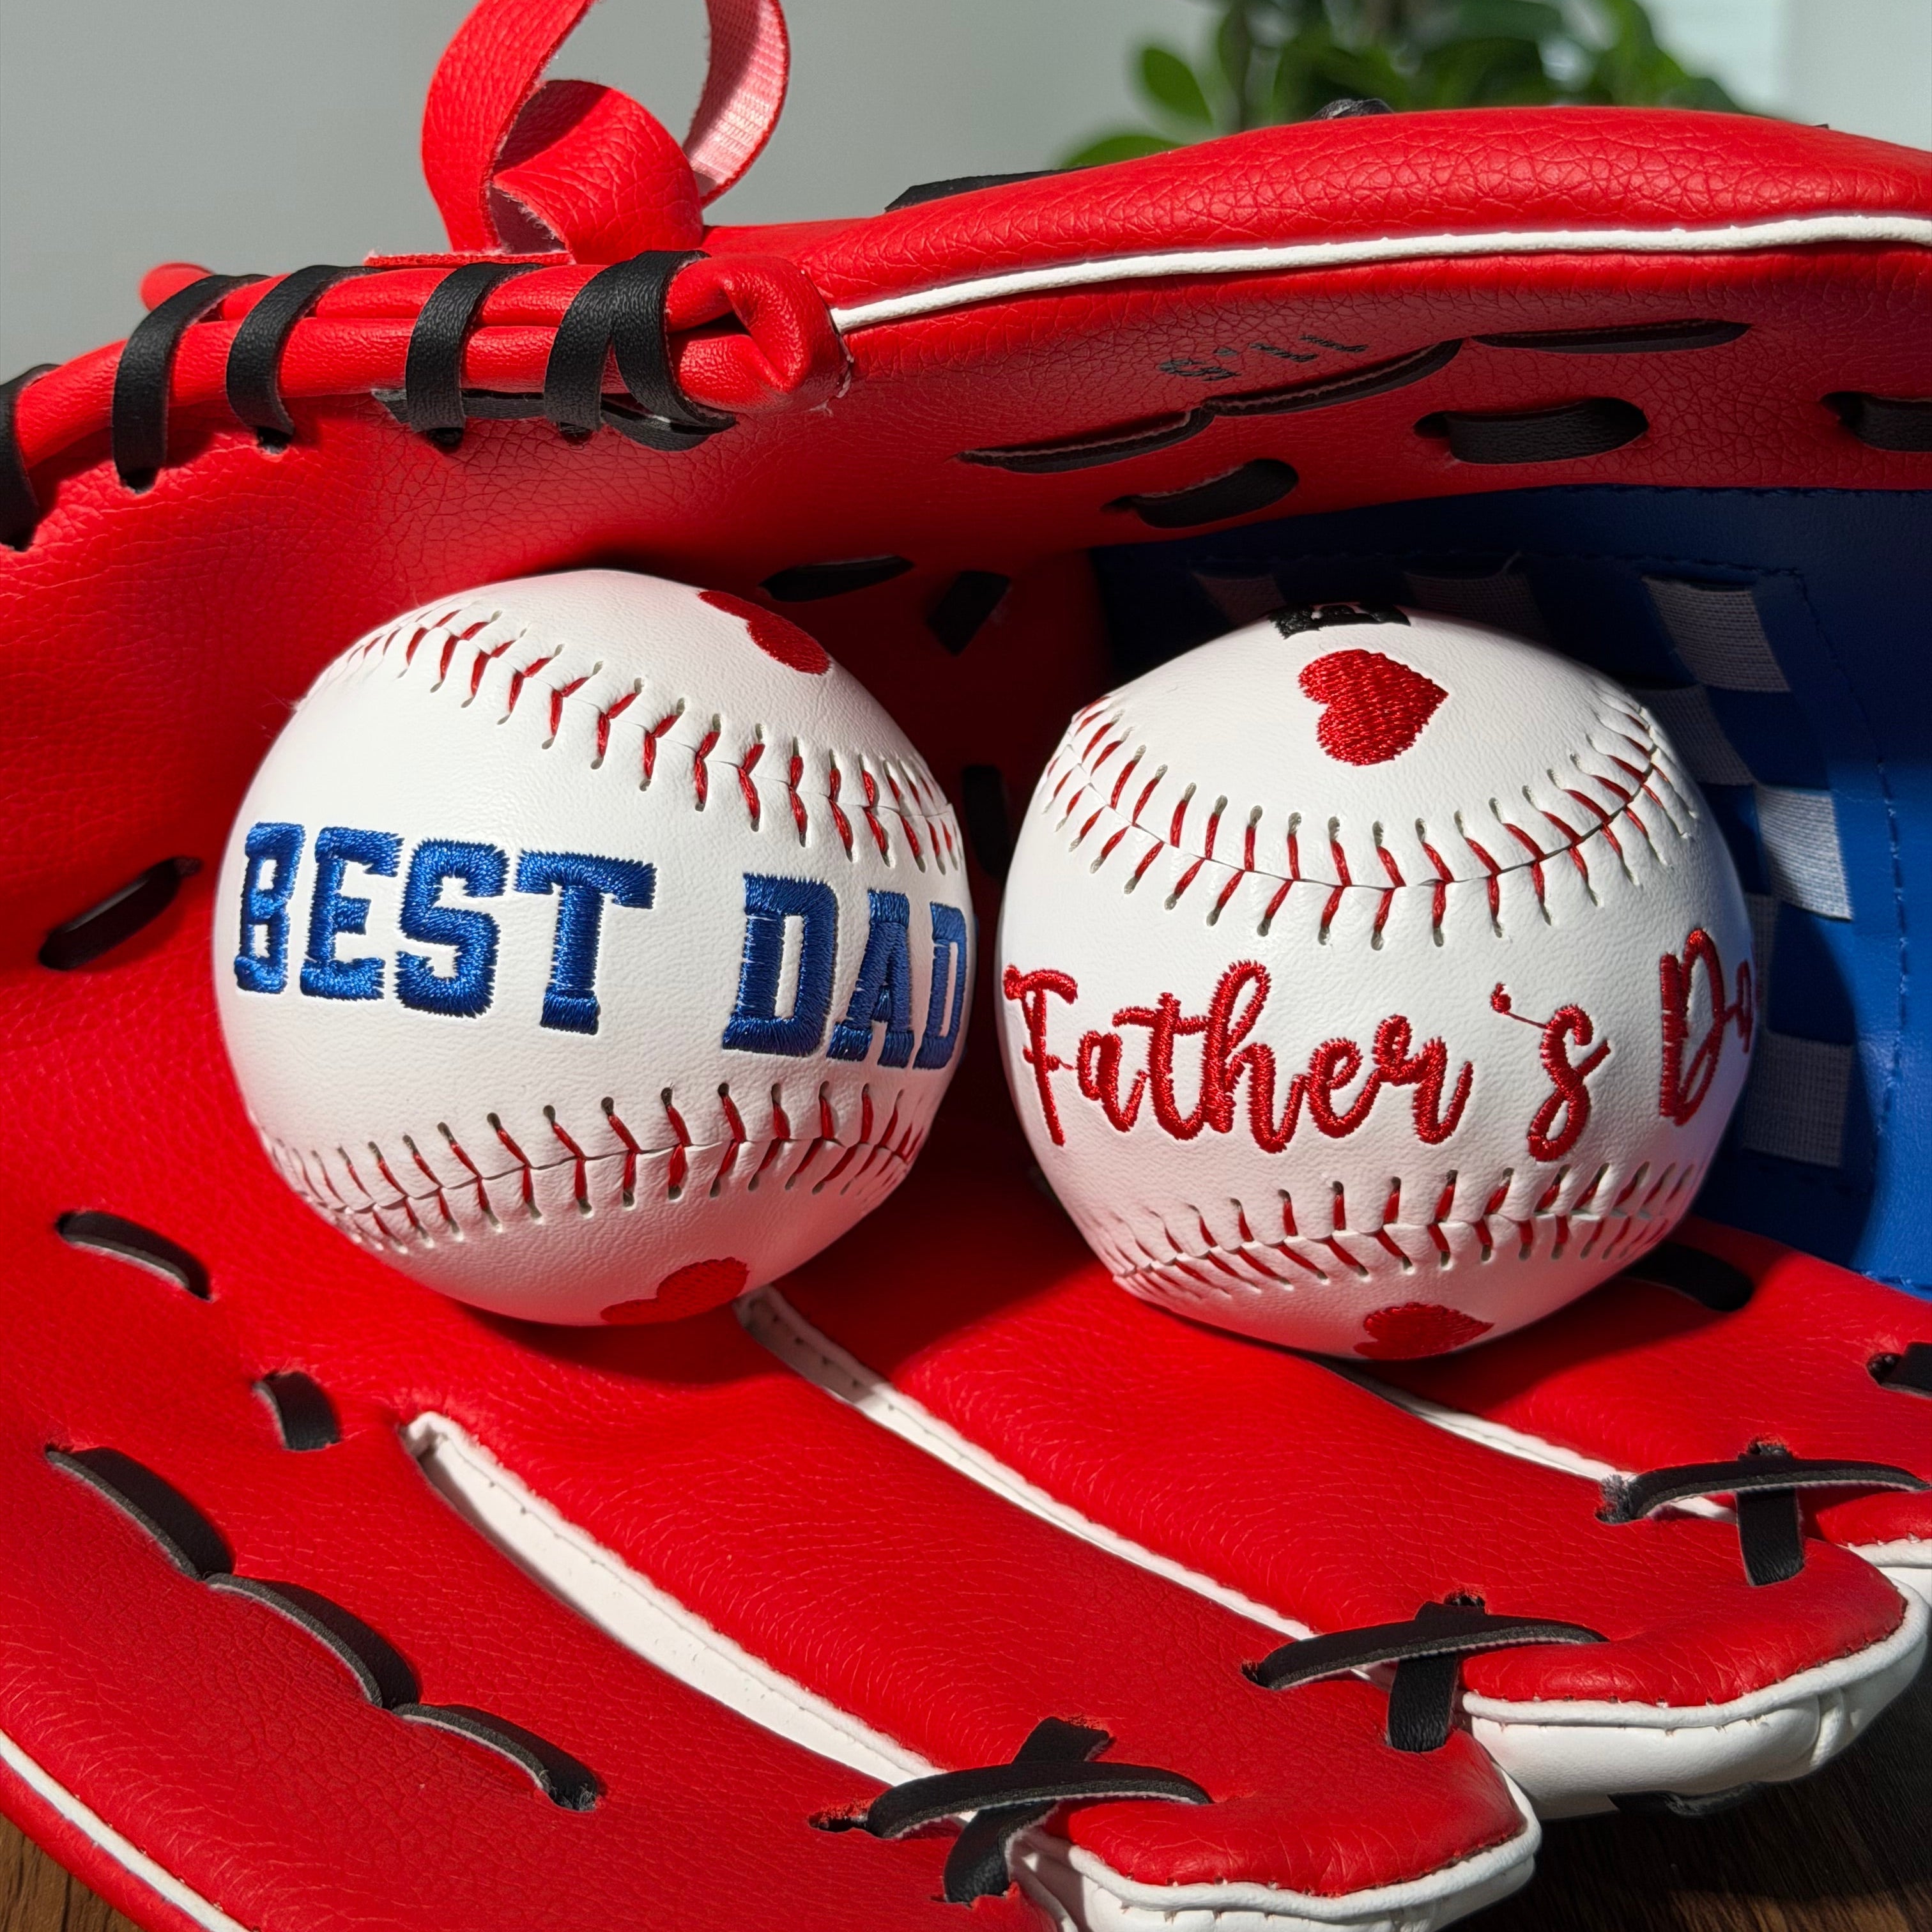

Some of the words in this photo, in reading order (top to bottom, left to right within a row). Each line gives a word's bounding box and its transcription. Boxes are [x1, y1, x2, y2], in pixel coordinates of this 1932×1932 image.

[234, 822, 658, 1035] BEST
[722, 871, 967, 1070] DAD
[1659, 928, 1753, 1126] Da
